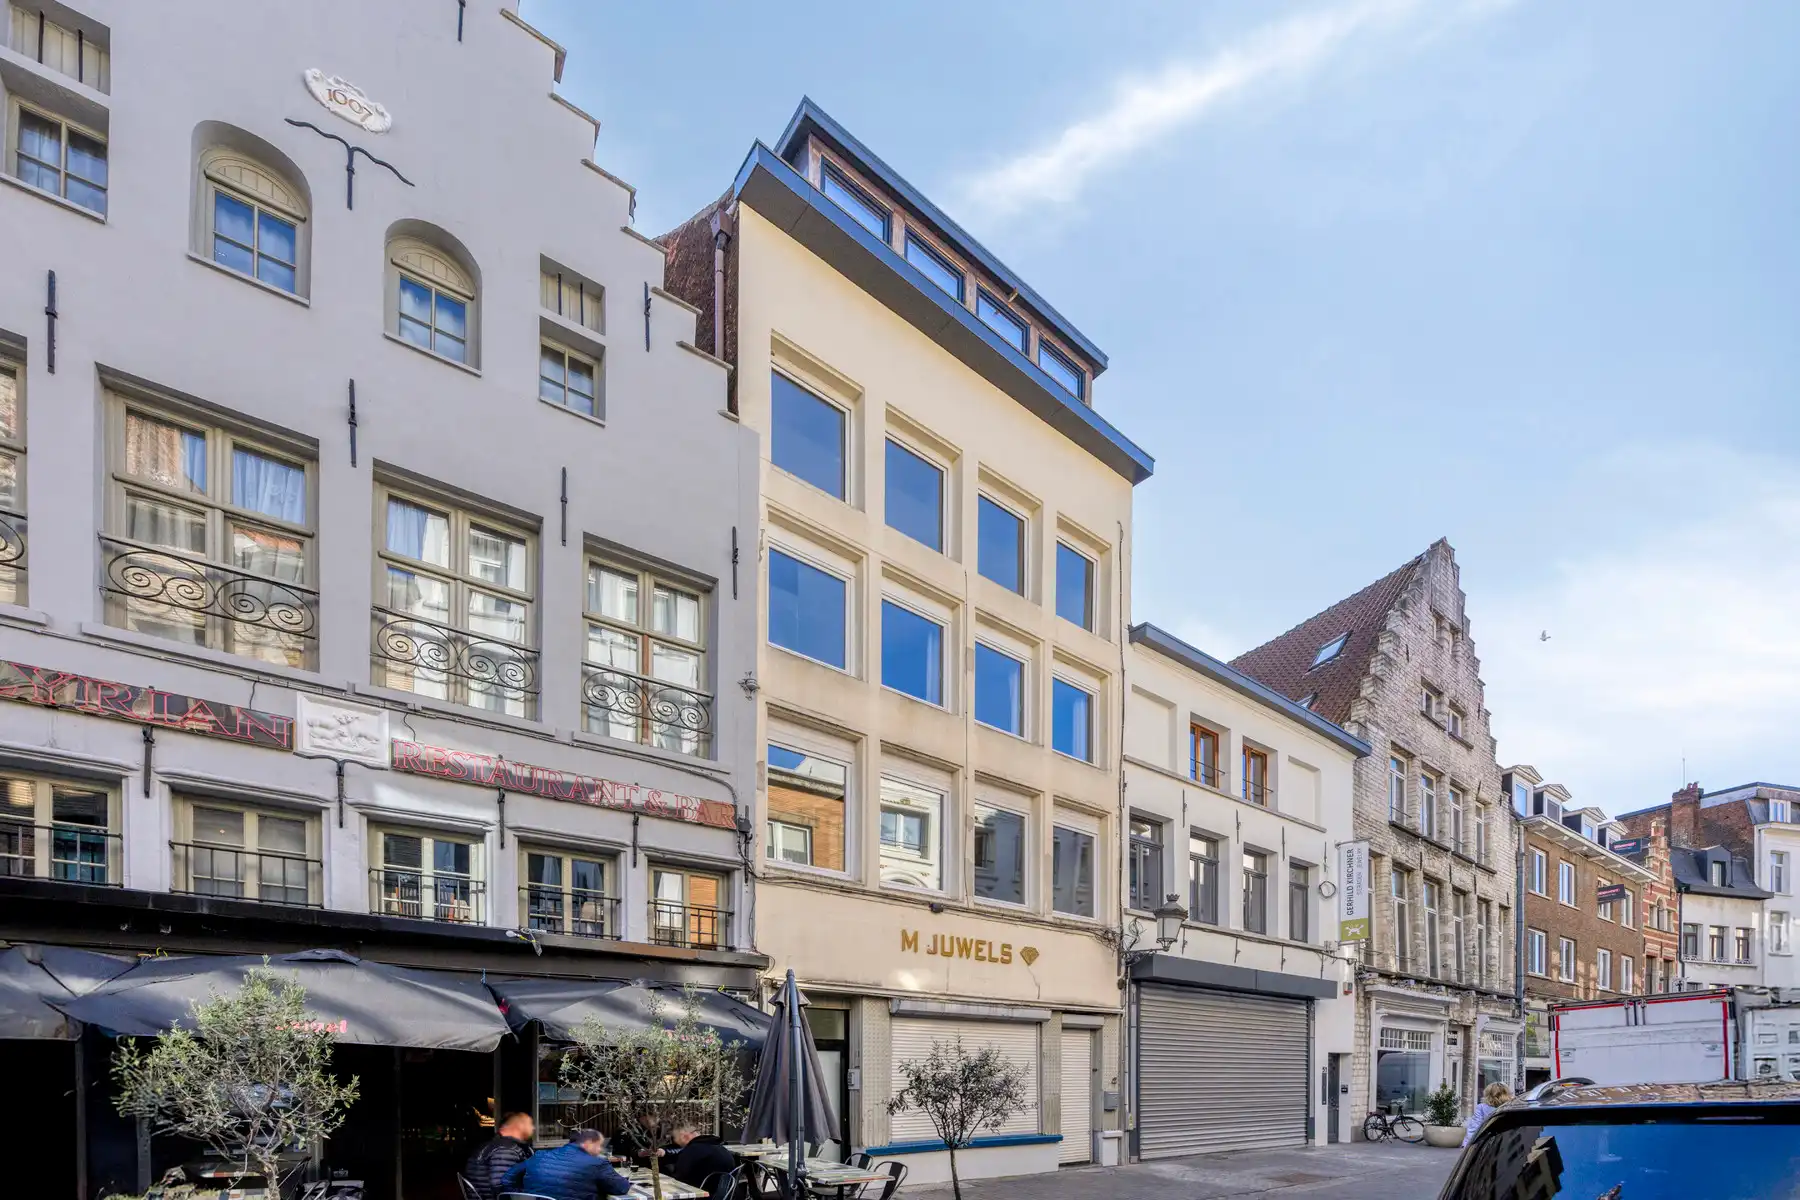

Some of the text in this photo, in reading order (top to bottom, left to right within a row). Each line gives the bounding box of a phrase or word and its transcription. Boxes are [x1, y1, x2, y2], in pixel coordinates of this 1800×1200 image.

[0, 661, 289, 747] YRIAN
[393, 738, 737, 829] RESTAURANT & BAR
[1346, 848, 1354, 916] GERHILD KIRCHNER
[901, 929, 1012, 964] M JUWELS
